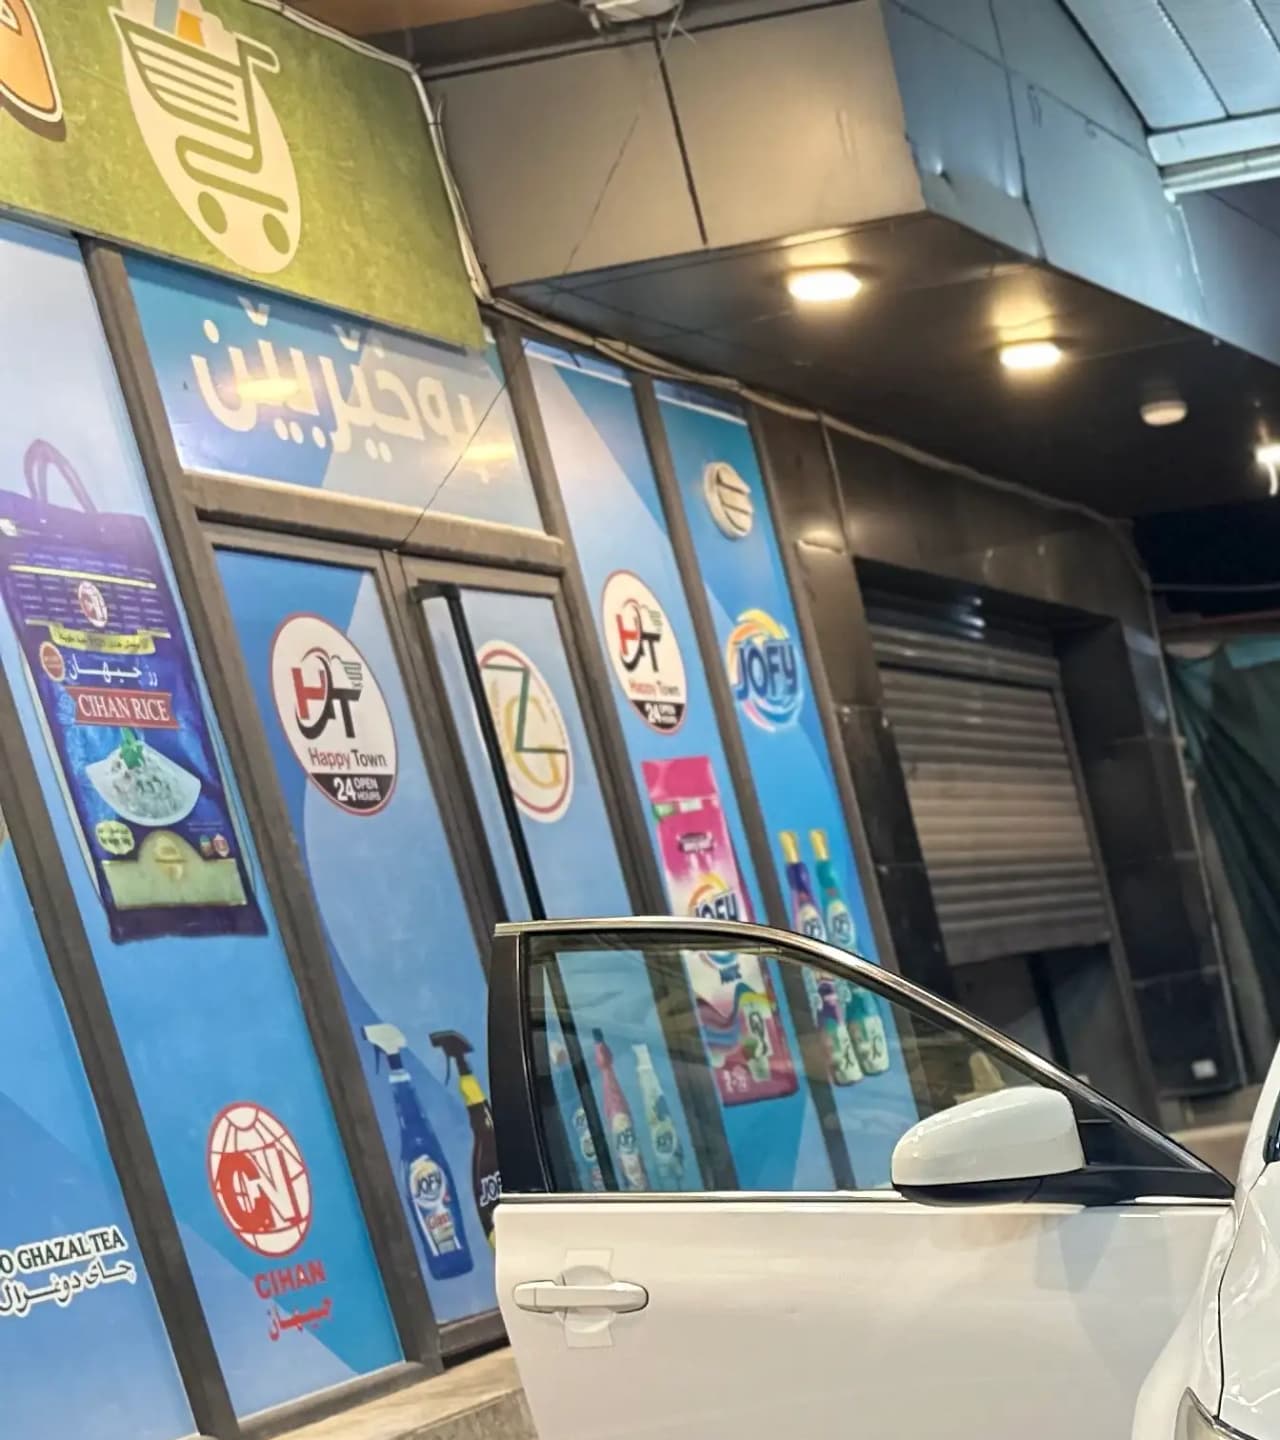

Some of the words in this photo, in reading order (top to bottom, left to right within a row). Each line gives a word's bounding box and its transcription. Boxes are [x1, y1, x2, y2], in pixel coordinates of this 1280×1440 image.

[78, 694, 131, 719] CIHAN
[133, 698, 170, 721] RICE
[308, 748, 350, 770] Happy
[351, 749, 387, 768] Town
[333, 777, 356, 801] 24
[354, 777, 378, 790] OPEN
[17, 1237, 91, 1270] GHAZAL
[88, 1228, 125, 1253] TEA
[254, 1260, 326, 1300] CIHAN
